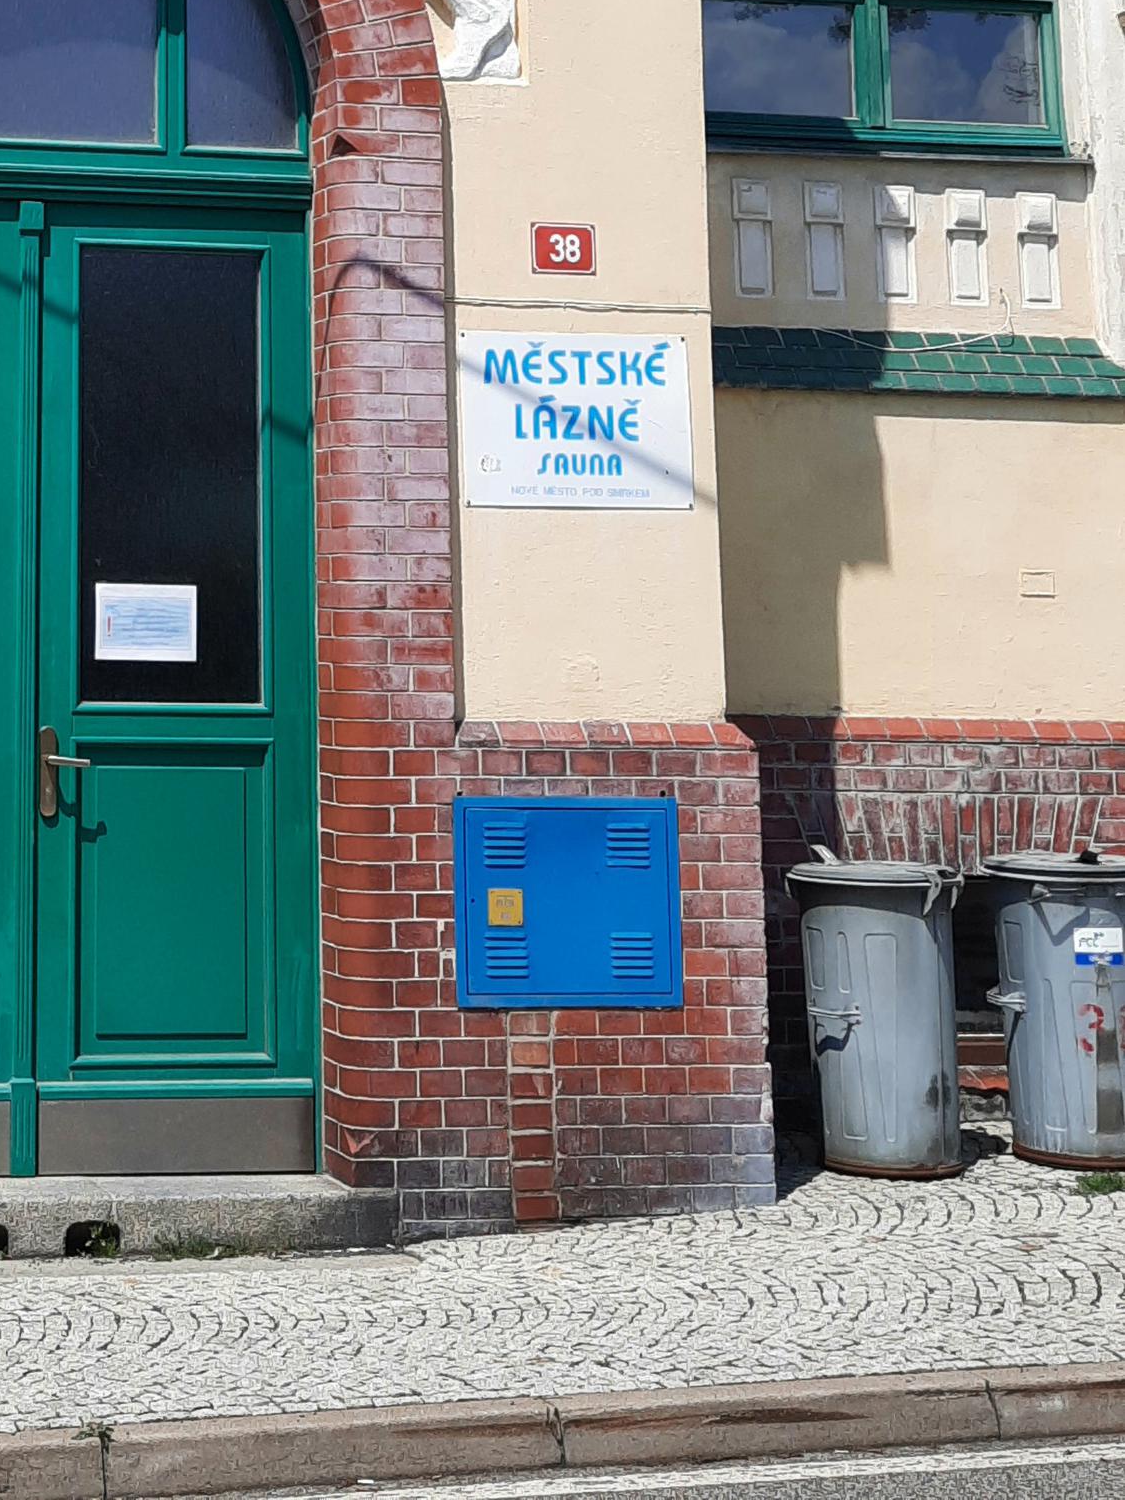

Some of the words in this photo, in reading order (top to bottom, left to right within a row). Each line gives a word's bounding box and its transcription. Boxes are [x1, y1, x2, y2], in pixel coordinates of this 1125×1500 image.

[549, 233, 581, 263] 38
[483, 340, 671, 387] MĚSTSKÉ
[515, 395, 642, 442] LÁZNĚ
[537, 452, 623, 477] SAUNA
